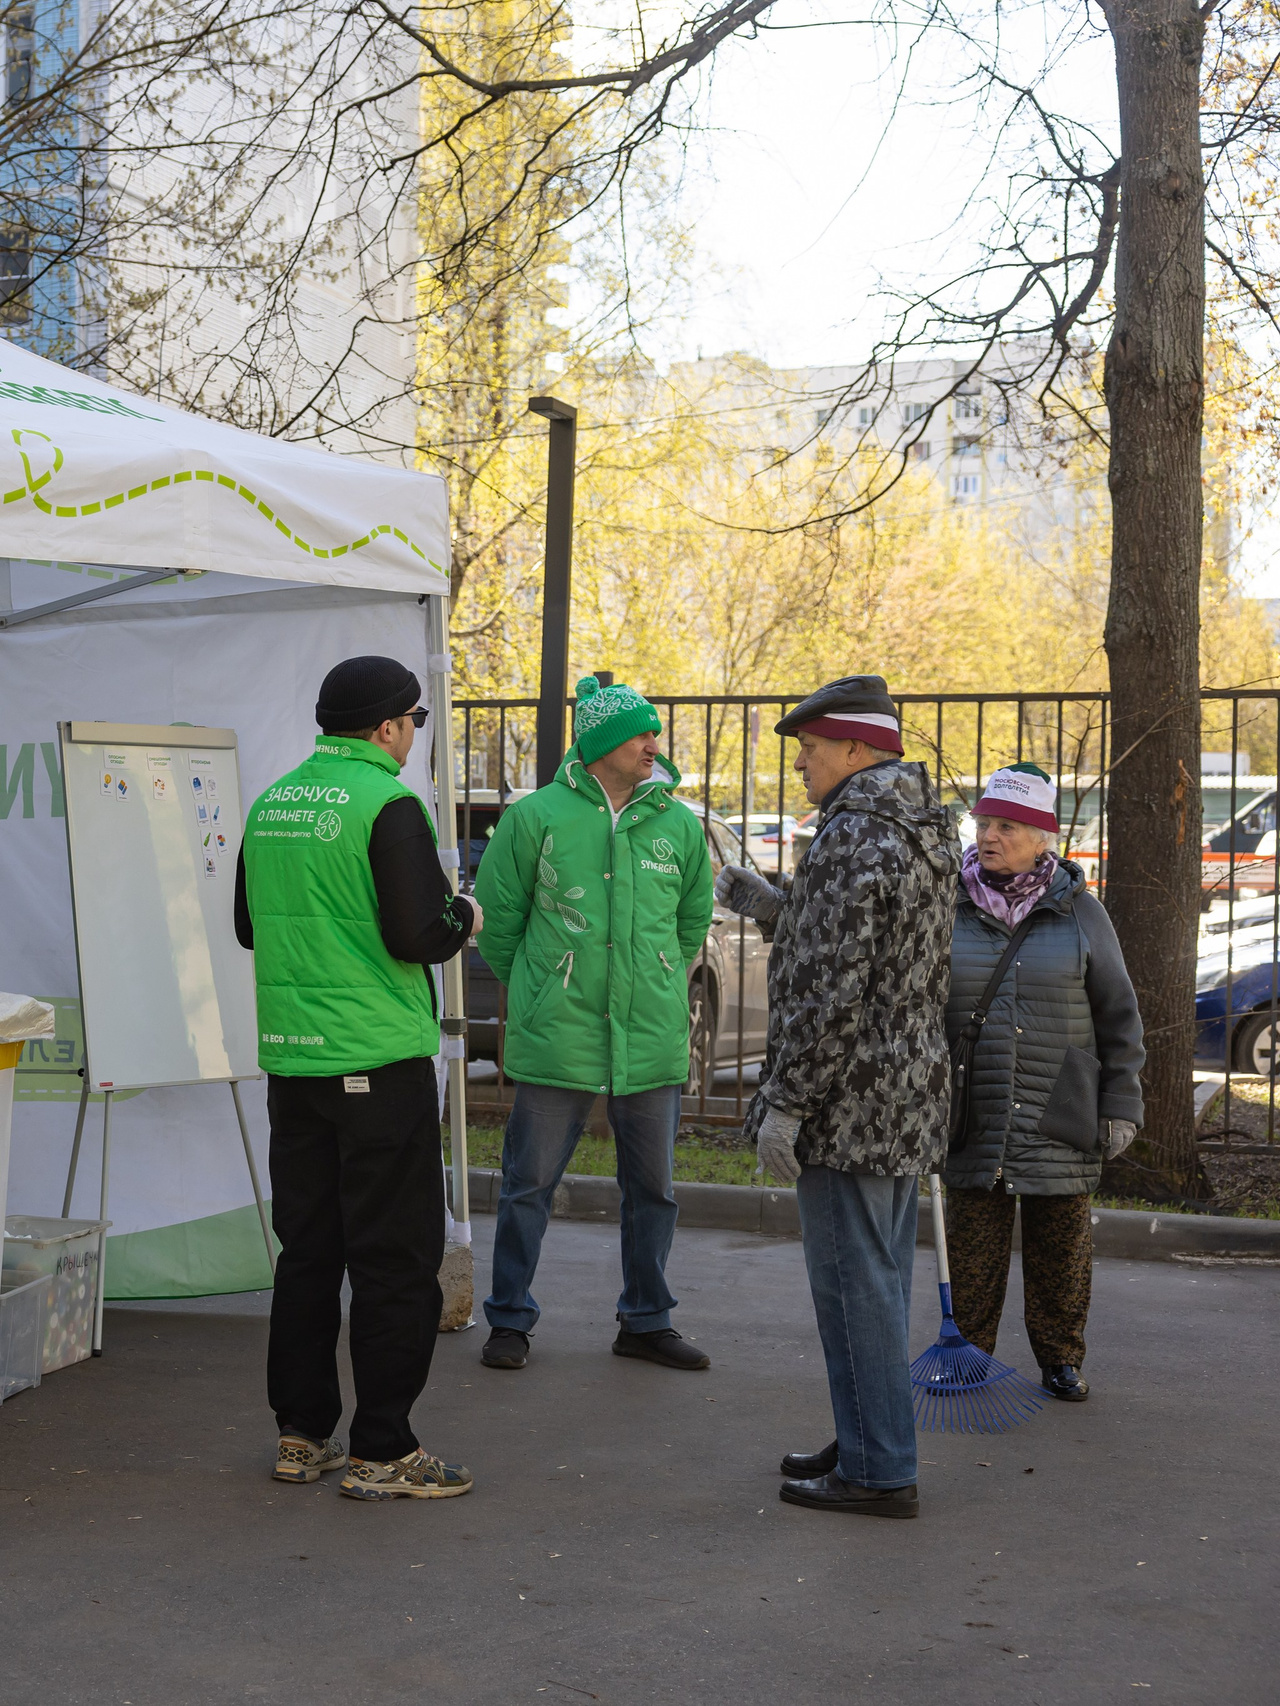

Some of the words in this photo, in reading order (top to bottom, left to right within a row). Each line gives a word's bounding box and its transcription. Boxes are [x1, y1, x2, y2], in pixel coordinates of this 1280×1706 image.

[316, 744, 339, 754] SYNER
[993, 783, 1029, 795] ДОЛГОЛЕТИЕ
[994, 778, 1031, 790] МОСКОВСКОЕ
[264, 785, 350, 804] ЗАБОЧУСЬ
[257, 810, 265, 822] О
[265, 809, 316, 822] ПЛАНЕТЕ
[270, 1034, 285, 1044] ECO
[287, 1035, 299, 1044] BE
